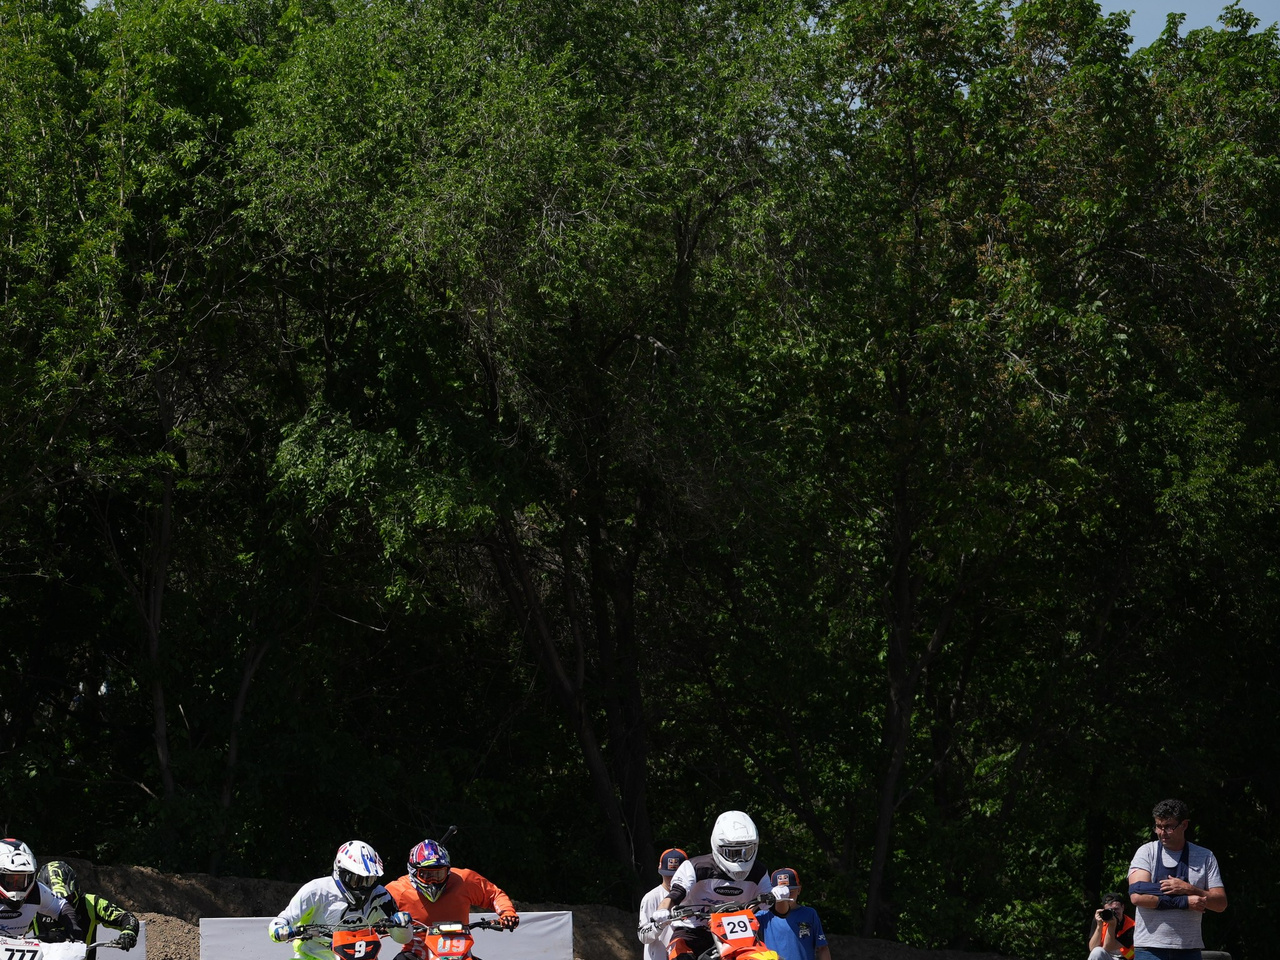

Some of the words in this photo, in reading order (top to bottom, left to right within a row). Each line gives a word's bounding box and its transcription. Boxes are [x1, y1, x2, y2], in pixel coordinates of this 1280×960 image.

[726, 920, 748, 934] 29
[354, 940, 366, 958] 9
[437, 936, 466, 953] 09
